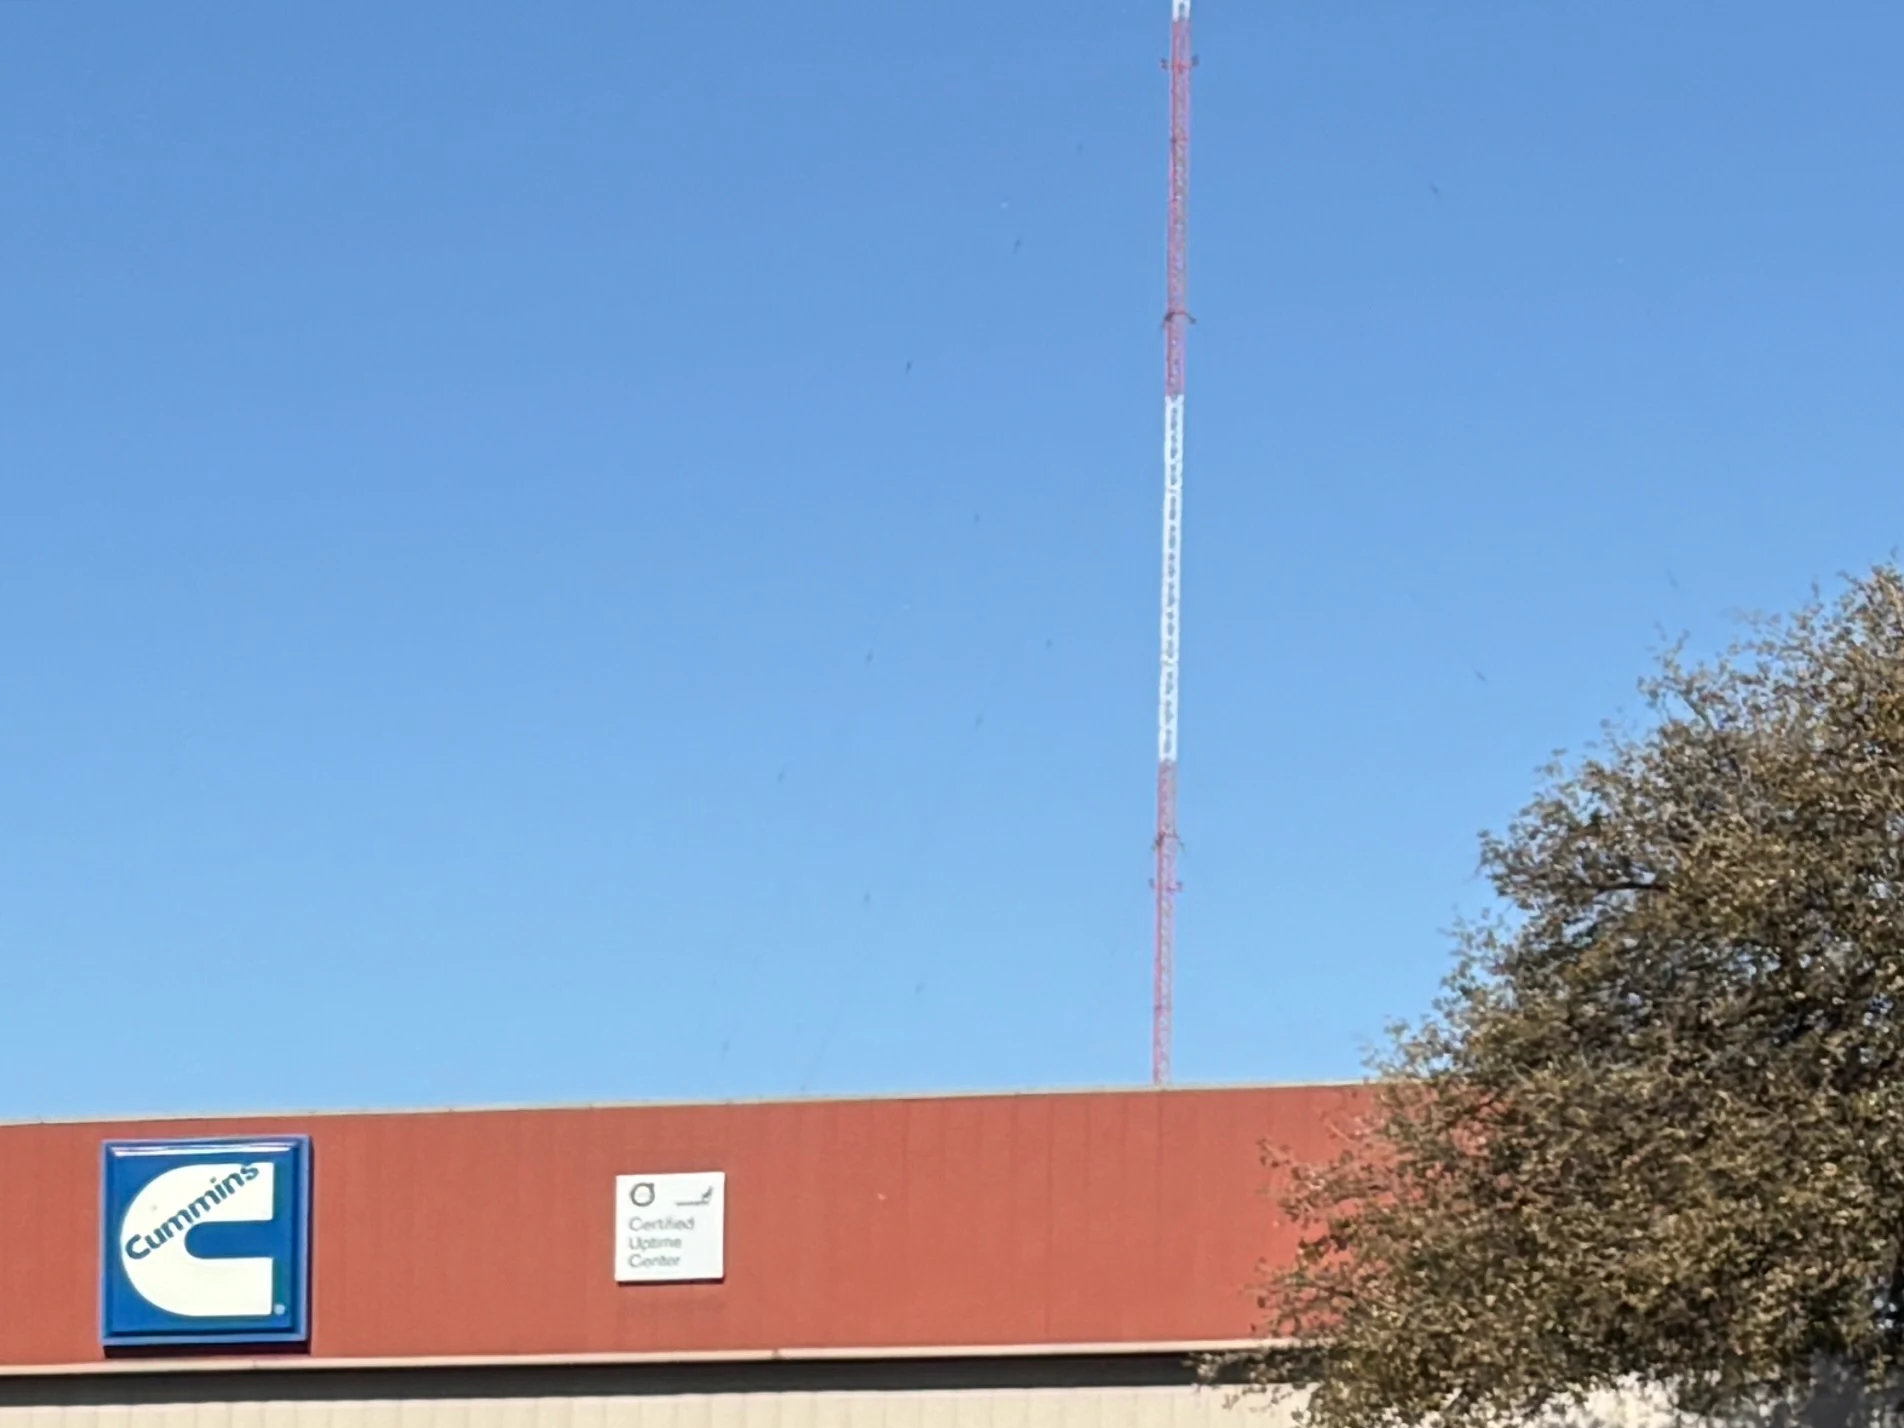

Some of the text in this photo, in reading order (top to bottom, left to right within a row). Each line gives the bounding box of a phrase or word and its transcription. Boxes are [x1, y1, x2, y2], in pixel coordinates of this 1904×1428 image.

[124, 1161, 260, 1260] Cummins
[628, 1216, 695, 1232] Certified
[628, 1236, 682, 1252] Uptime
[628, 1254, 681, 1268] Center
